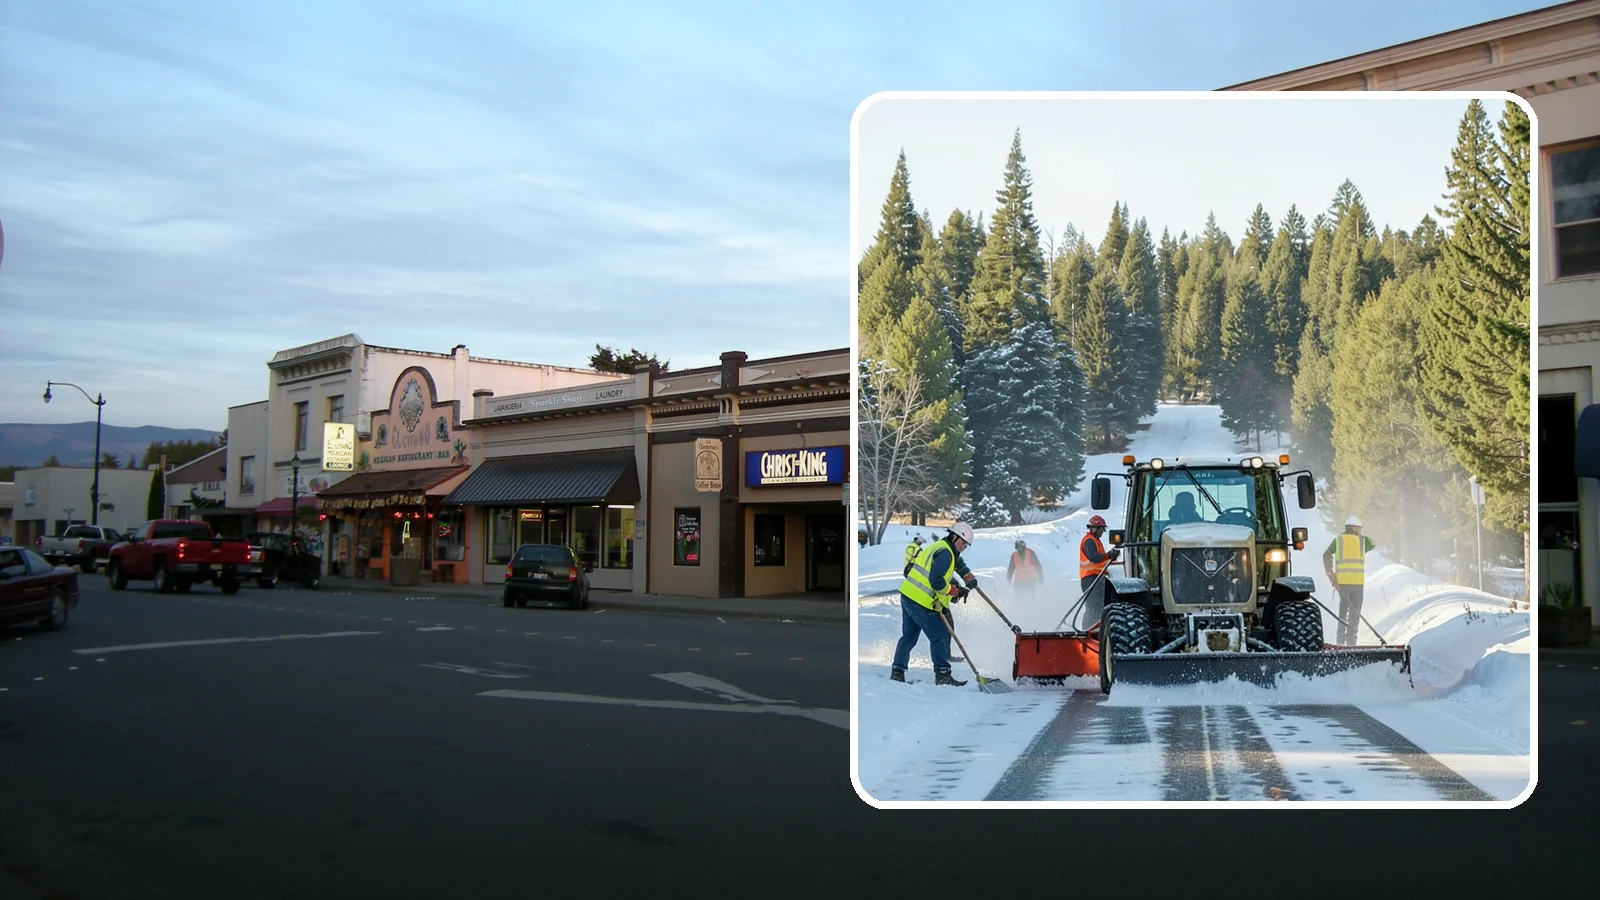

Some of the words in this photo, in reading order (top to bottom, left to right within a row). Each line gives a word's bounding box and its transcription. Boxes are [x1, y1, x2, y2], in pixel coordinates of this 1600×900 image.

[494, 402, 522, 412] LAVANDERIA
[531, 399, 561, 409] Sparkle
[562, 395, 582, 405] Shop
[596, 389, 623, 400] LAUNDRY
[374, 455, 397, 464] MEXICAN
[398, 451, 433, 462] RESTAURANT
[438, 450, 450, 460] BAR
[761, 452, 797, 477] CHRIST
[799, 450, 827, 476] KING
[696, 481, 709, 489] Coffee
